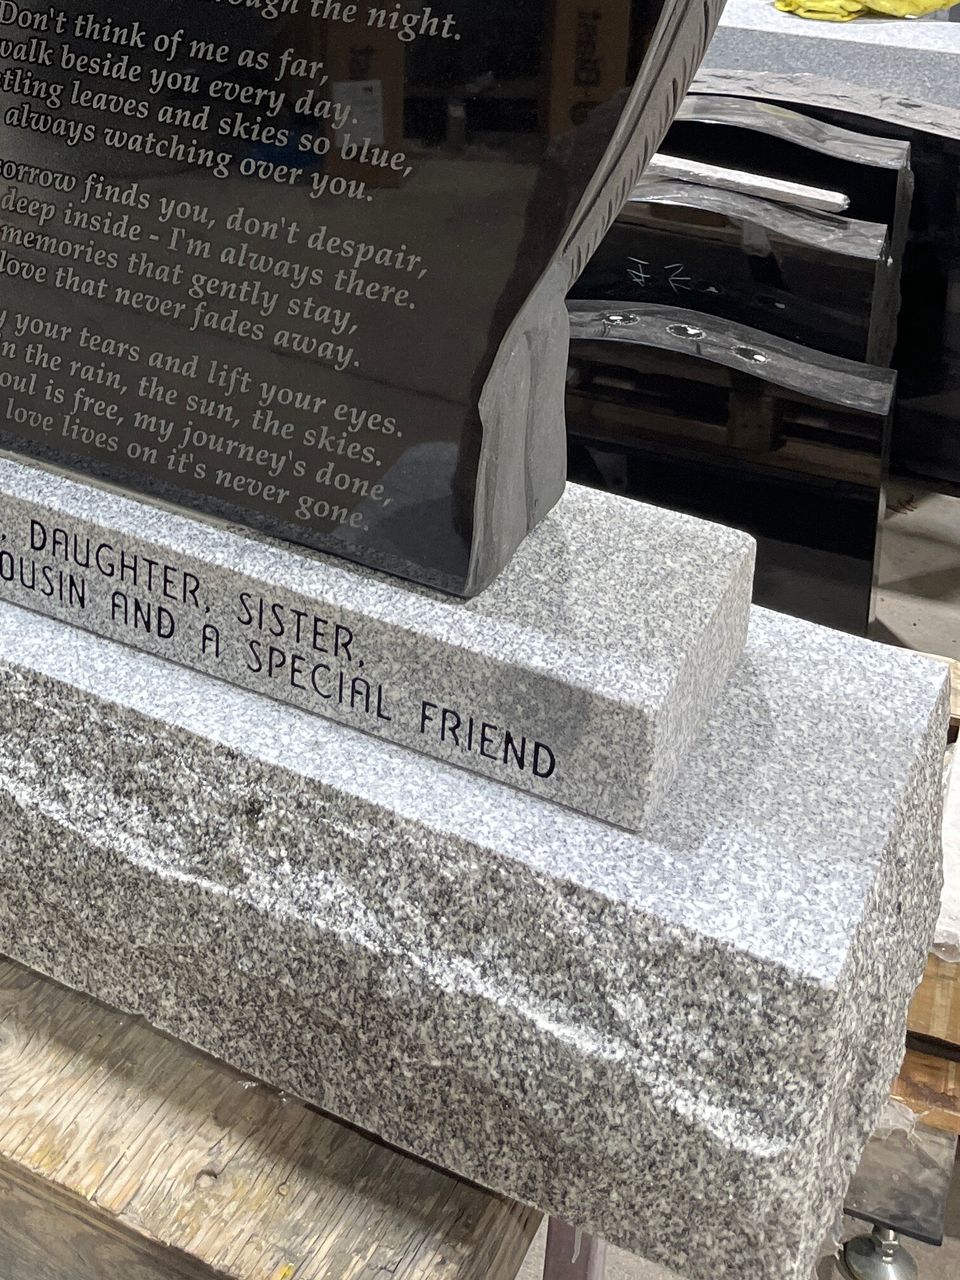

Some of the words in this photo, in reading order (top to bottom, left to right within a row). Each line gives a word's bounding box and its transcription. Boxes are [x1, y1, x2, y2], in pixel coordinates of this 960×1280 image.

[75, 11, 145, 48] think
[154, 27, 182, 60] of
[190, 40, 228, 63] me
[238, 48, 269, 70] as
[277, 47, 329, 87] far,
[367, 5, 462, 43] night.
[61, 47, 141, 83] beside
[150, 68, 200, 97] you
[209, 79, 285, 120] every
[295, 88, 358, 128] day.
[70, 81, 150, 118] leaves
[157, 105, 210, 131] and
[218, 113, 290, 148] skies
[298, 133, 330, 155] so
[341, 134, 413, 177] blue,
[6, 104, 96, 147] always
[104, 129, 232, 179] watching
[240, 158, 303, 185] over
[310, 172, 373, 202] you.
[0, 224, 119, 269] memories
[127, 252, 184, 285] that
[188, 273, 279, 317] gently
[288, 296, 358, 336] stay,
[1, 188, 55, 226] deep
[64, 203, 141, 241] inside
[167, 227, 211, 259] I'm
[220, 243, 323, 289] always
[334, 269, 416, 310] there.
[82, 173, 151, 210] finds
[159, 197, 216, 229] you,
[226, 207, 300, 244] don't
[307, 225, 428, 280] despair,
[55, 266, 109, 299] that
[115, 285, 186, 319] never
[190, 302, 265, 340] fades
[273, 328, 360, 371] away.
[14, 313, 72, 342] your
[79, 327, 141, 362] tears
[148, 351, 198, 379] and
[207, 360, 253, 397] lift
[258, 382, 327, 414] your
[334, 403, 403, 439] eyes.
[25, 343, 62, 372] the
[69, 359, 128, 396] rain,
[138, 376, 178, 405] the
[186, 395, 241, 429] sun,
[251, 409, 295, 440] the
[303, 426, 382, 467] skies.
[6, 398, 54, 432] love
[62, 415, 120, 453] lives
[127, 442, 159, 465] on
[167, 448, 207, 480] it's
[215, 466, 290, 504] never
[294, 495, 369, 531] gone.
[44, 379, 66, 404] is
[70, 387, 125, 425] free,
[134, 412, 174, 442] my
[178, 421, 306, 477] journey's
[315, 462, 392, 507] done,
[31, 521, 210, 613] DAUGHTER,
[238, 591, 365, 668] SISTER,
[111, 590, 176, 640] AND
[201, 624, 220, 658] A
[247, 642, 392, 721] SPECIAL
[419, 700, 557, 779] FRIEND
